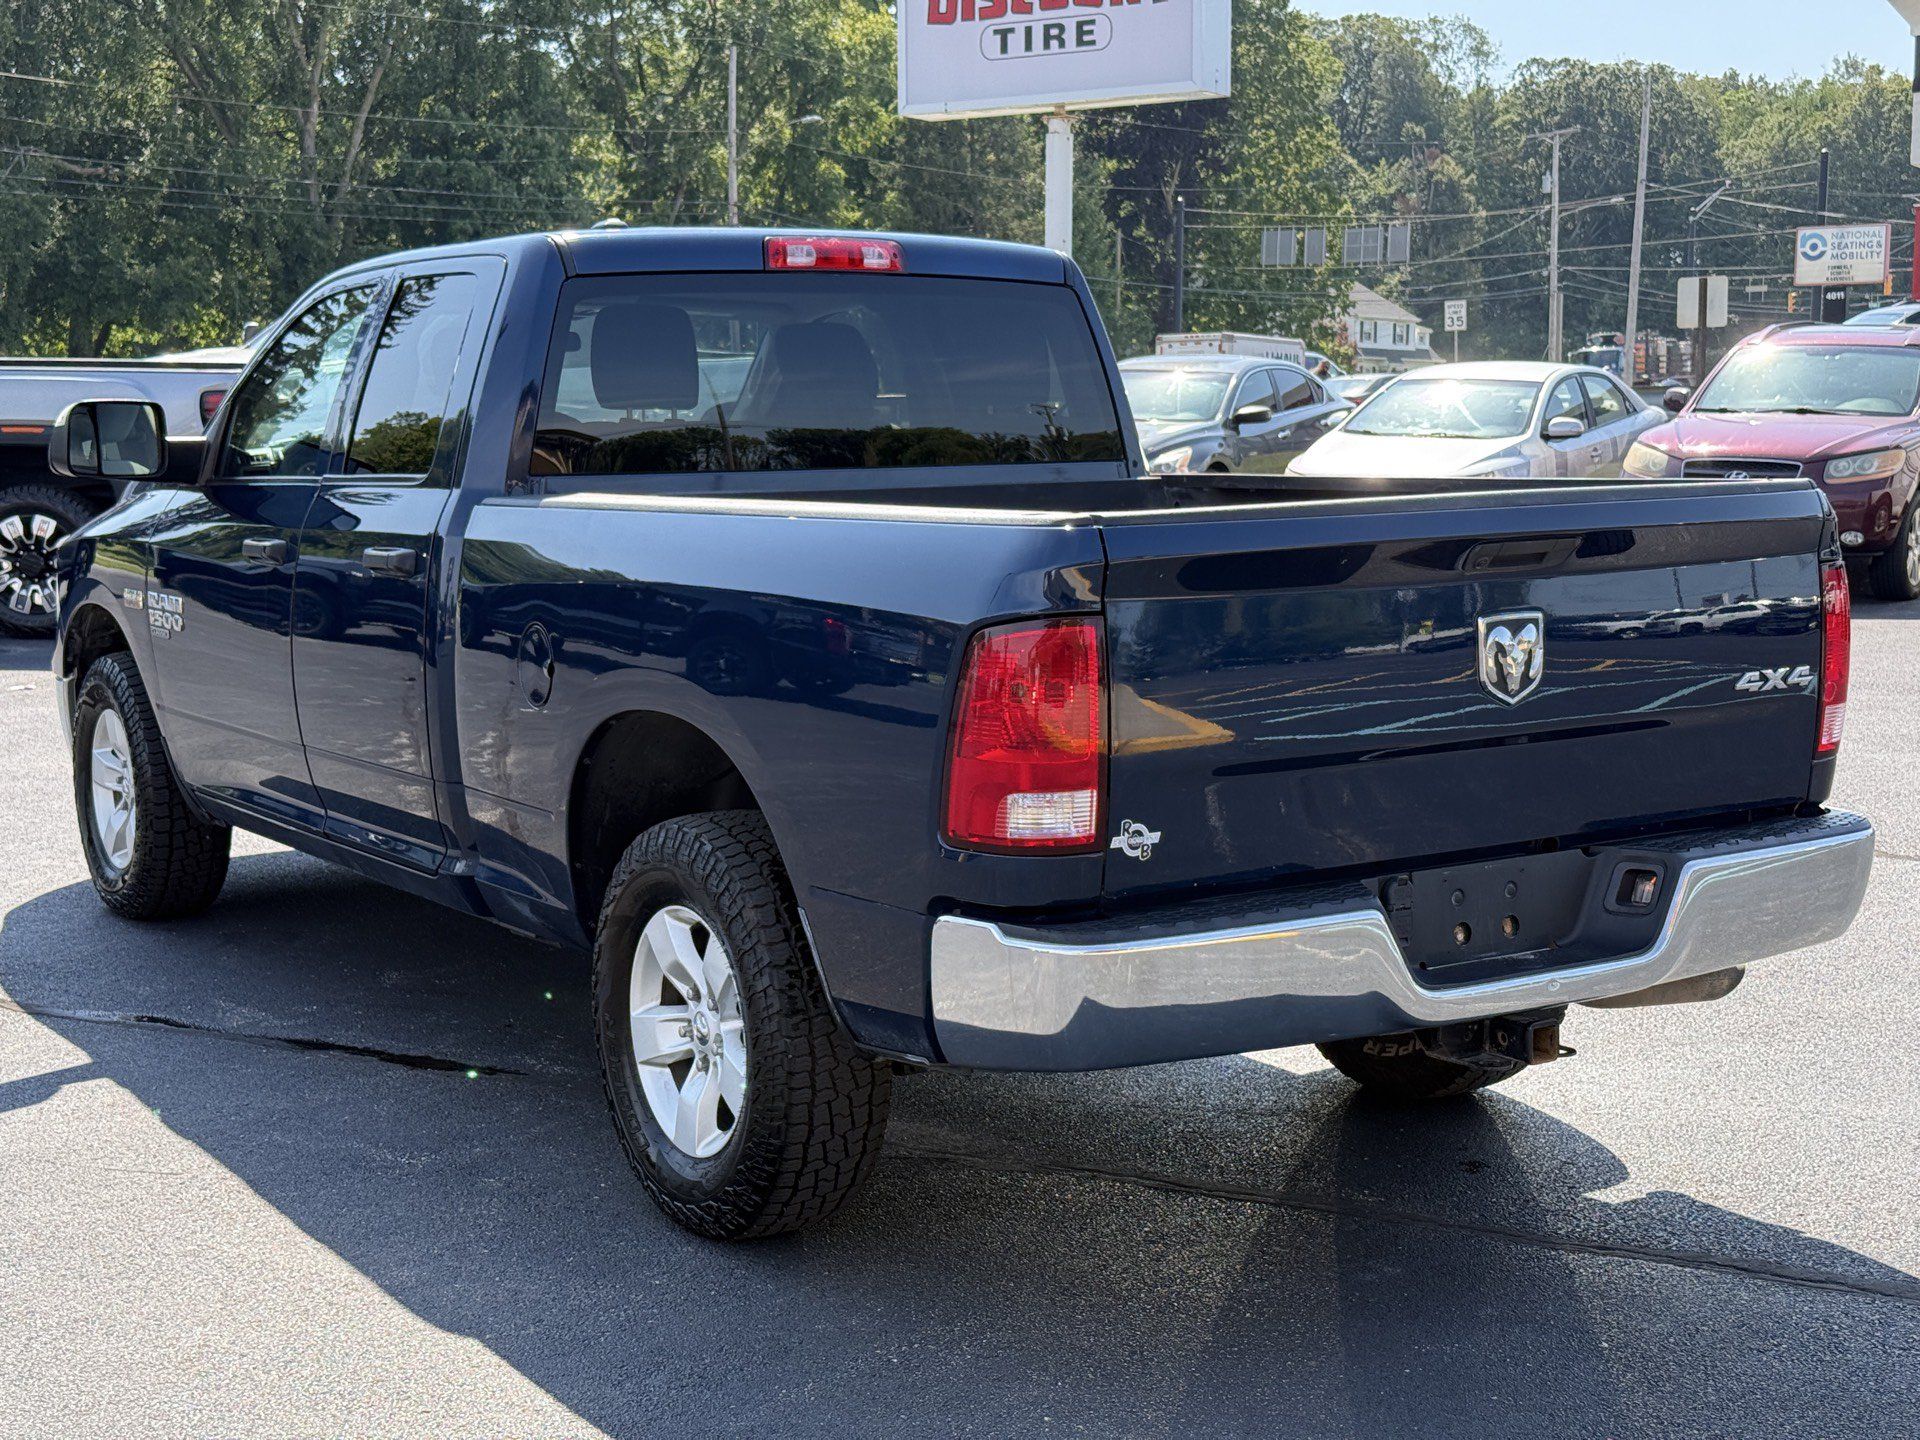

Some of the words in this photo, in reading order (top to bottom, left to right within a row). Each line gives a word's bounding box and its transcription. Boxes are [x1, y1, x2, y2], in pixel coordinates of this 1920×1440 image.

[992, 19, 1097, 55] TIRE
[1830, 230, 1883, 240] NATIONAL
[1830, 240, 1875, 250] SEATING
[1876, 240, 1883, 249] &
[1830, 250, 1882, 260] MOBILITY
[1825, 291, 1845, 301] 4011
[1447, 316, 1464, 327] 35
[147, 590, 183, 614] RAM
[148, 609, 184, 632] 1500
[1734, 665, 1814, 692] 4X4
